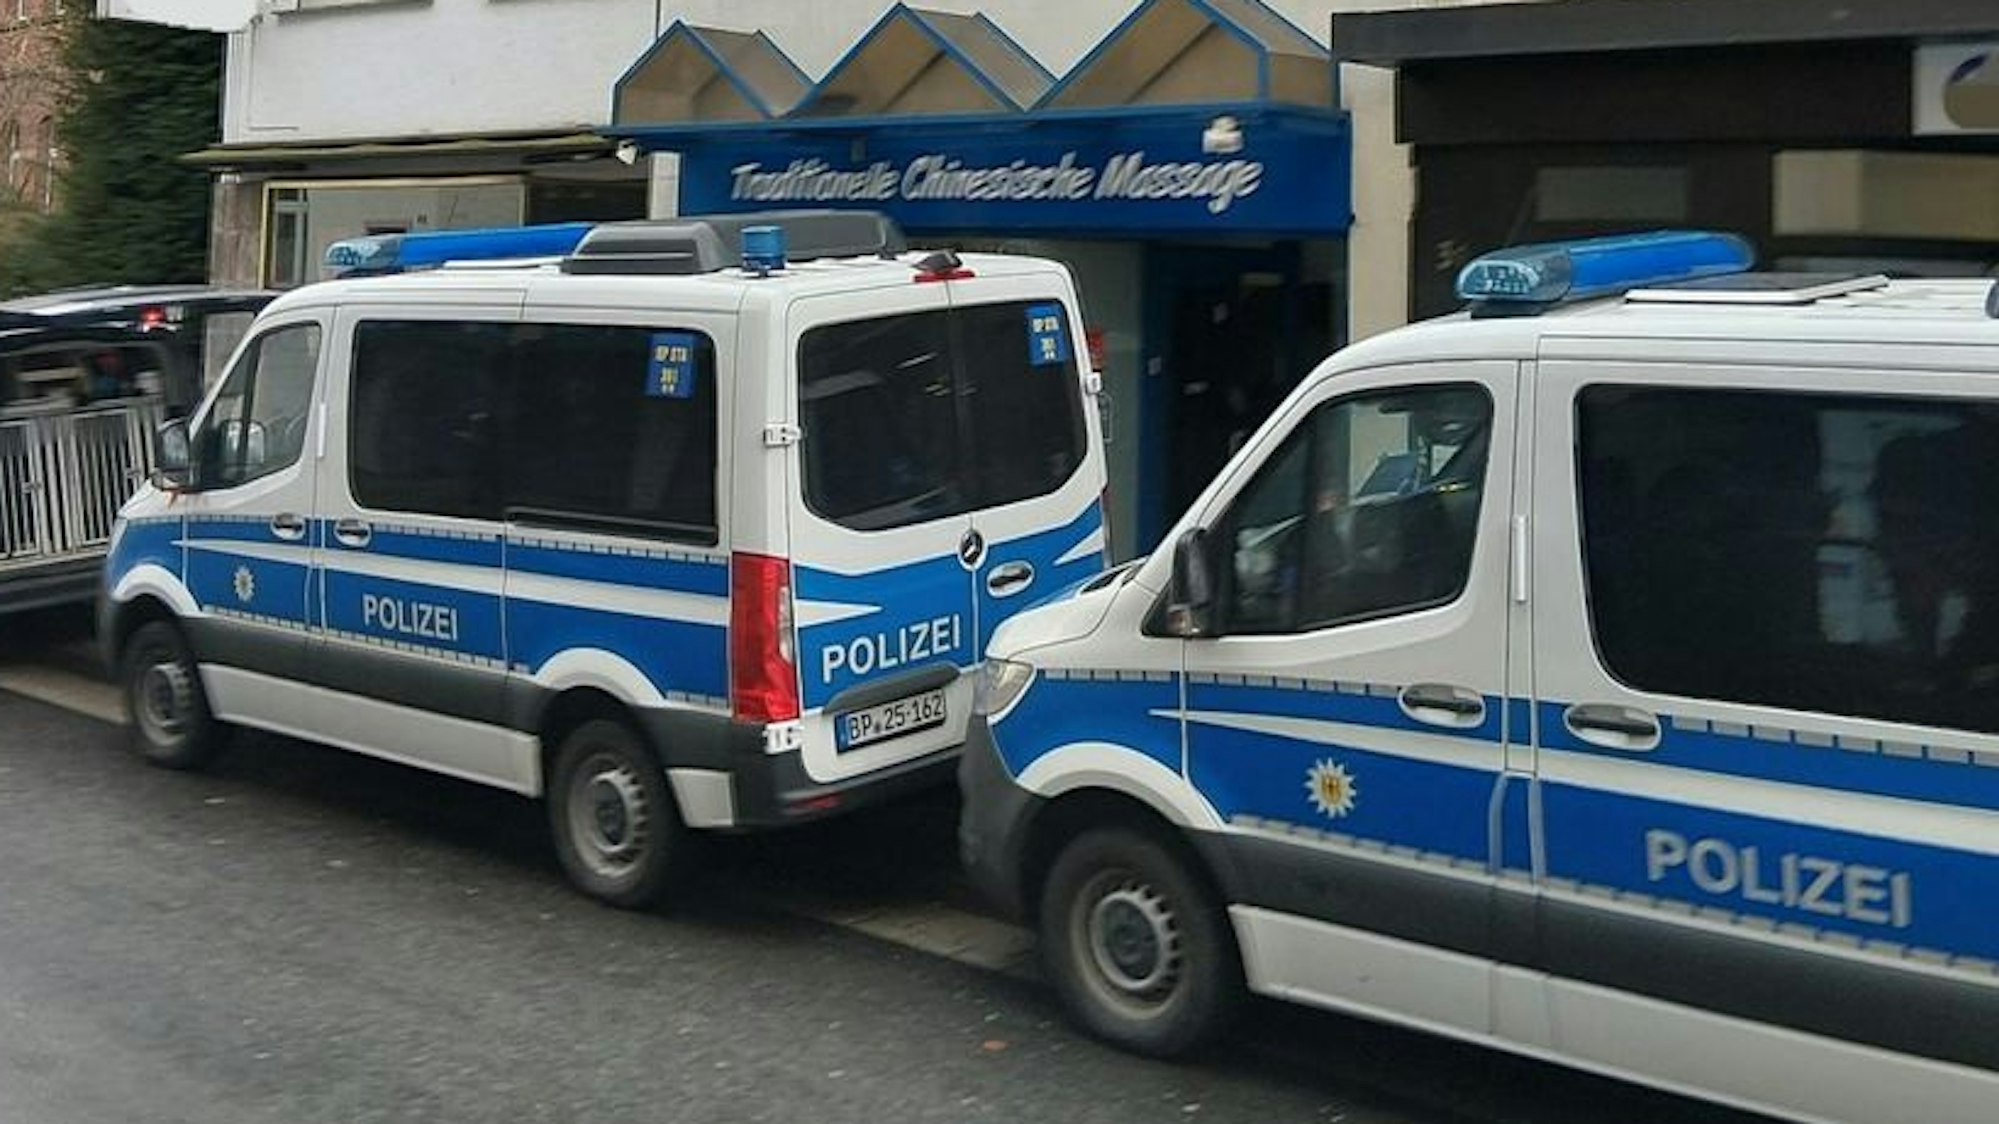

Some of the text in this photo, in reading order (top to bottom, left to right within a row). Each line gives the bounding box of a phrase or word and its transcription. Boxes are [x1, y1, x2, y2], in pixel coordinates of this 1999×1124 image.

[731, 151, 1264, 213] Traditionelle Chinesische Massage
[362, 593, 458, 641] POLIZEI
[822, 613, 960, 684] POLIZEI
[848, 713, 871, 740] BP
[1645, 829, 1911, 928] POLIZEI
